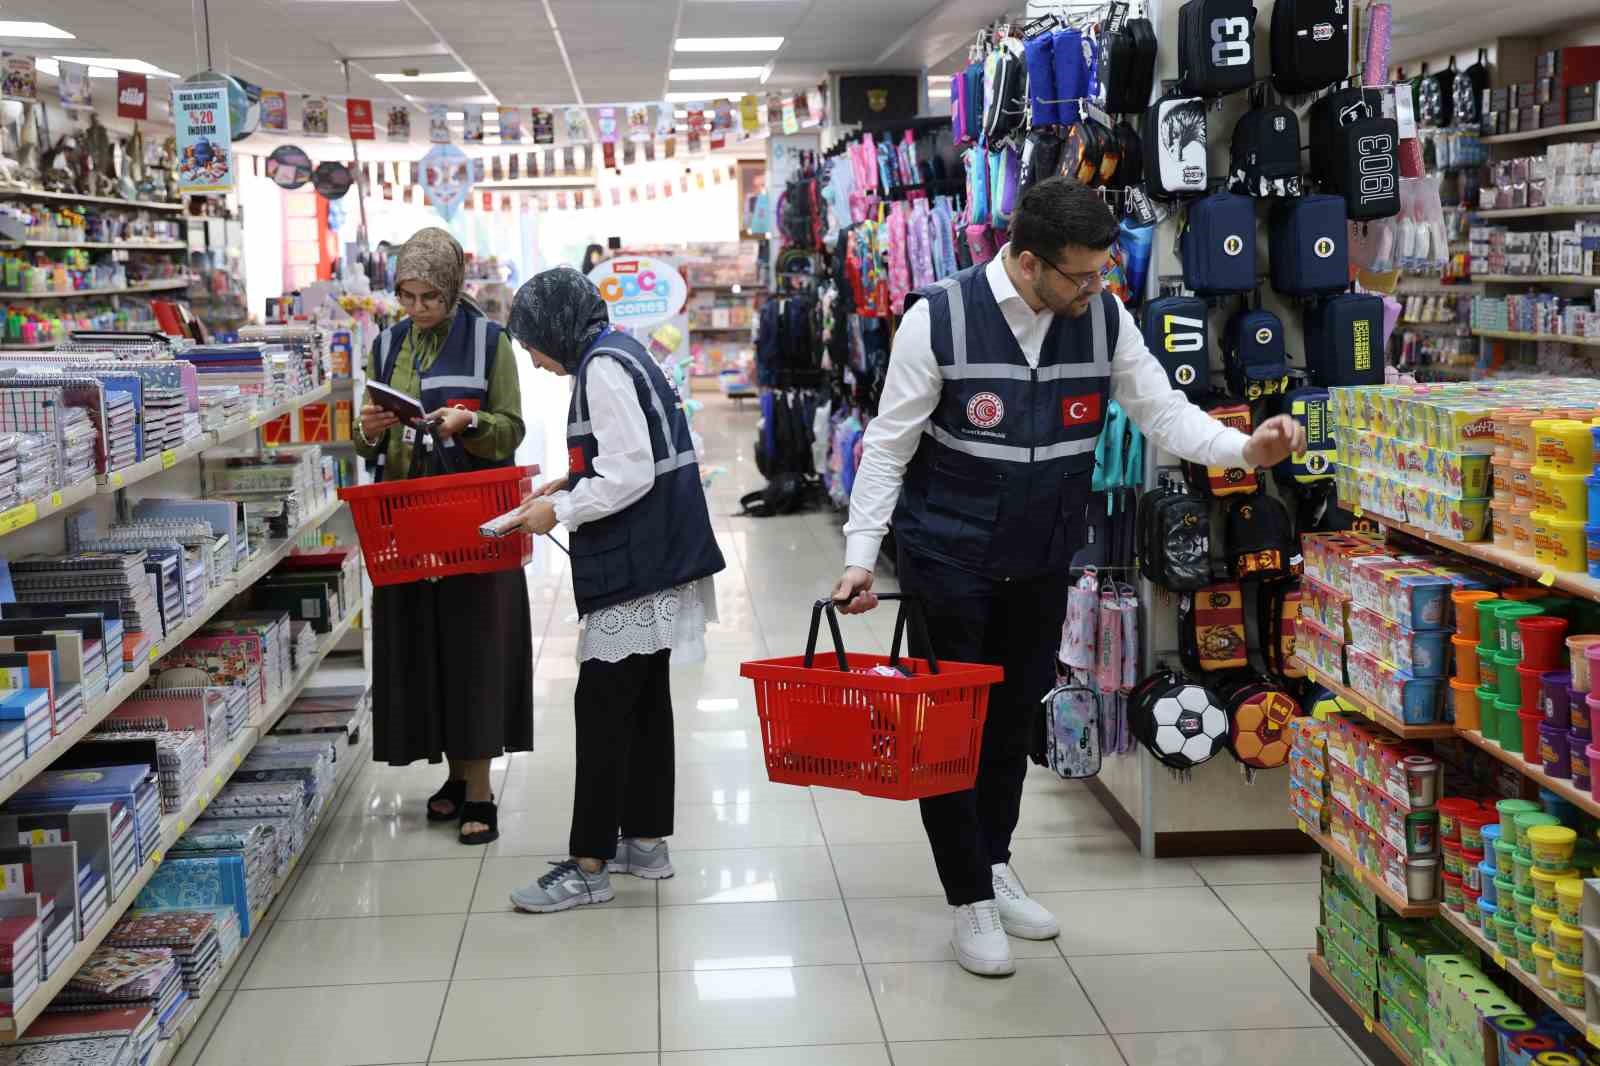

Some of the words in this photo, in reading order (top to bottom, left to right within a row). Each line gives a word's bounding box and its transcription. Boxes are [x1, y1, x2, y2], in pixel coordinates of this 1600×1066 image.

[1211, 16, 1250, 66] 03
[1359, 134, 1394, 205] 1903
[1164, 315, 1204, 352] 07
